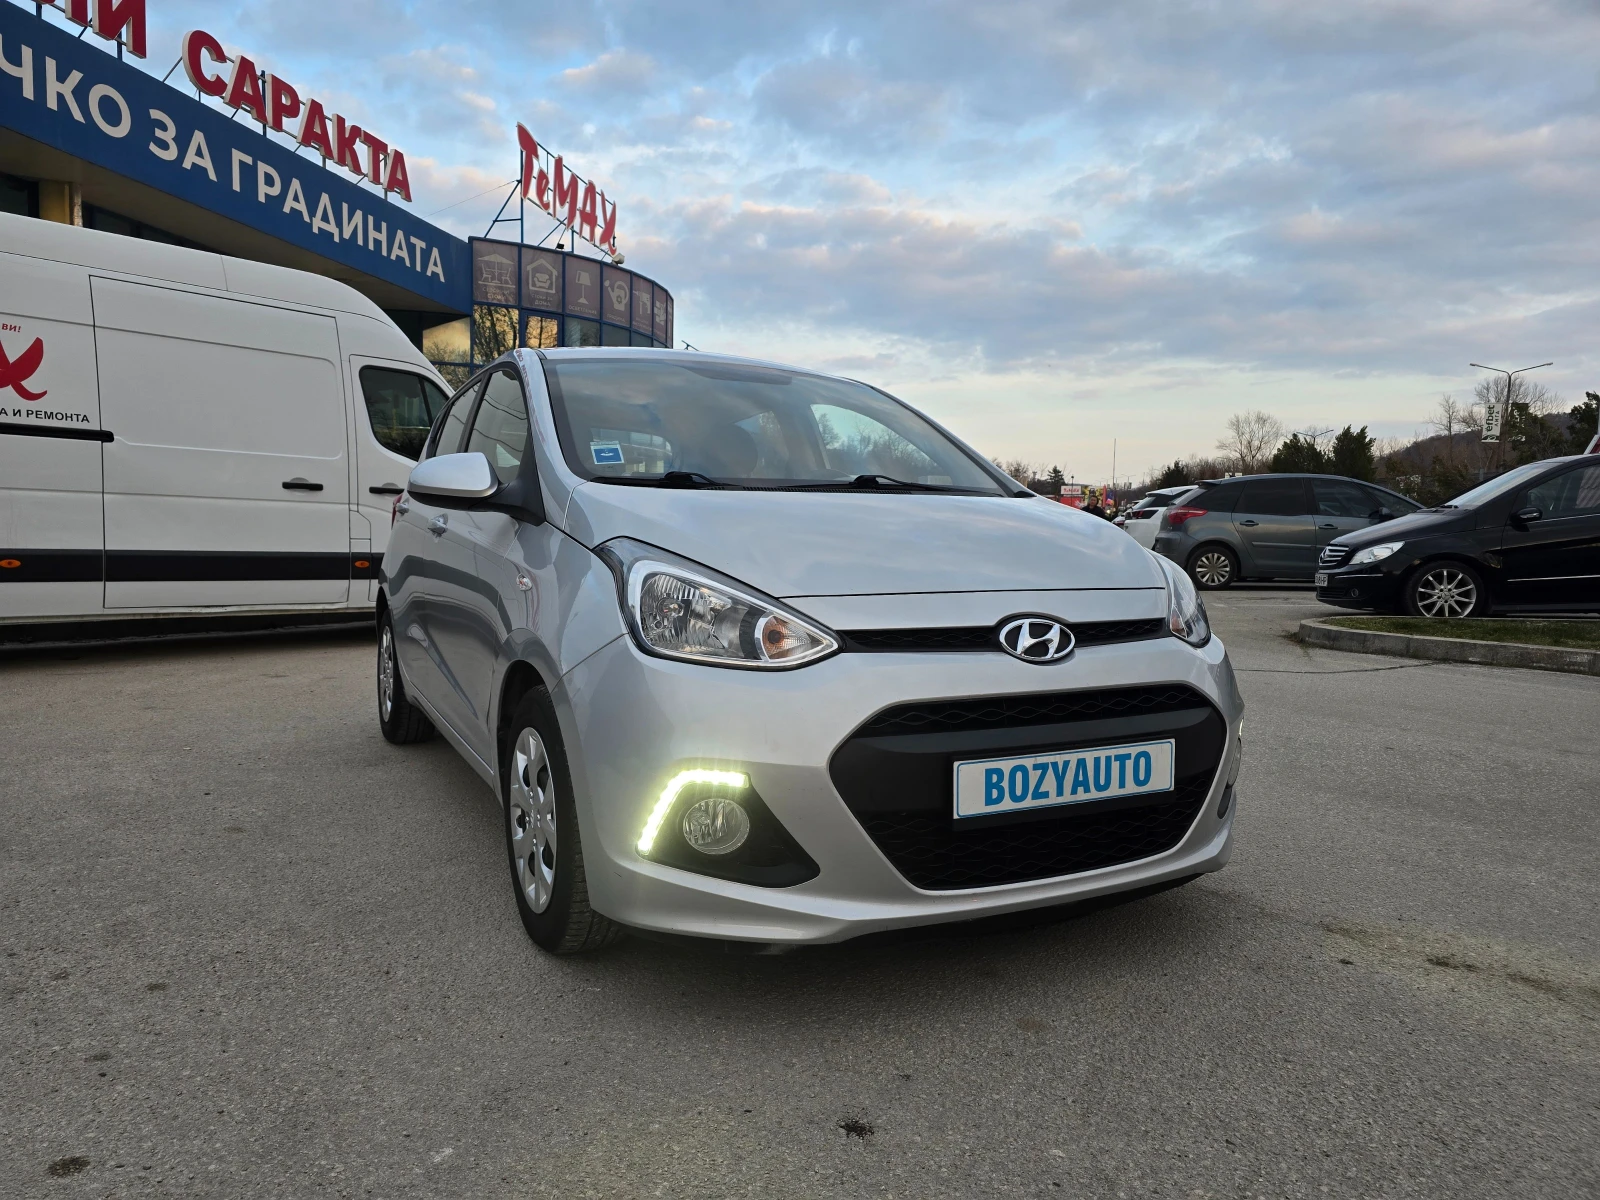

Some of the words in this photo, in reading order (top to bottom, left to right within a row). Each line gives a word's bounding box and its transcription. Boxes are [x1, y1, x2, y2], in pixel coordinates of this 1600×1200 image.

[182, 29, 412, 202] САРАКТА
[148, 108, 218, 182] ЗА
[231, 147, 446, 283] ГРАДИНАТА
[1, 323, 21, 333] ВИ!
[12, 408, 22, 418] И
[26, 409, 91, 424] РЕМОНТА
[984, 750, 1152, 807] BOZYAUTO
